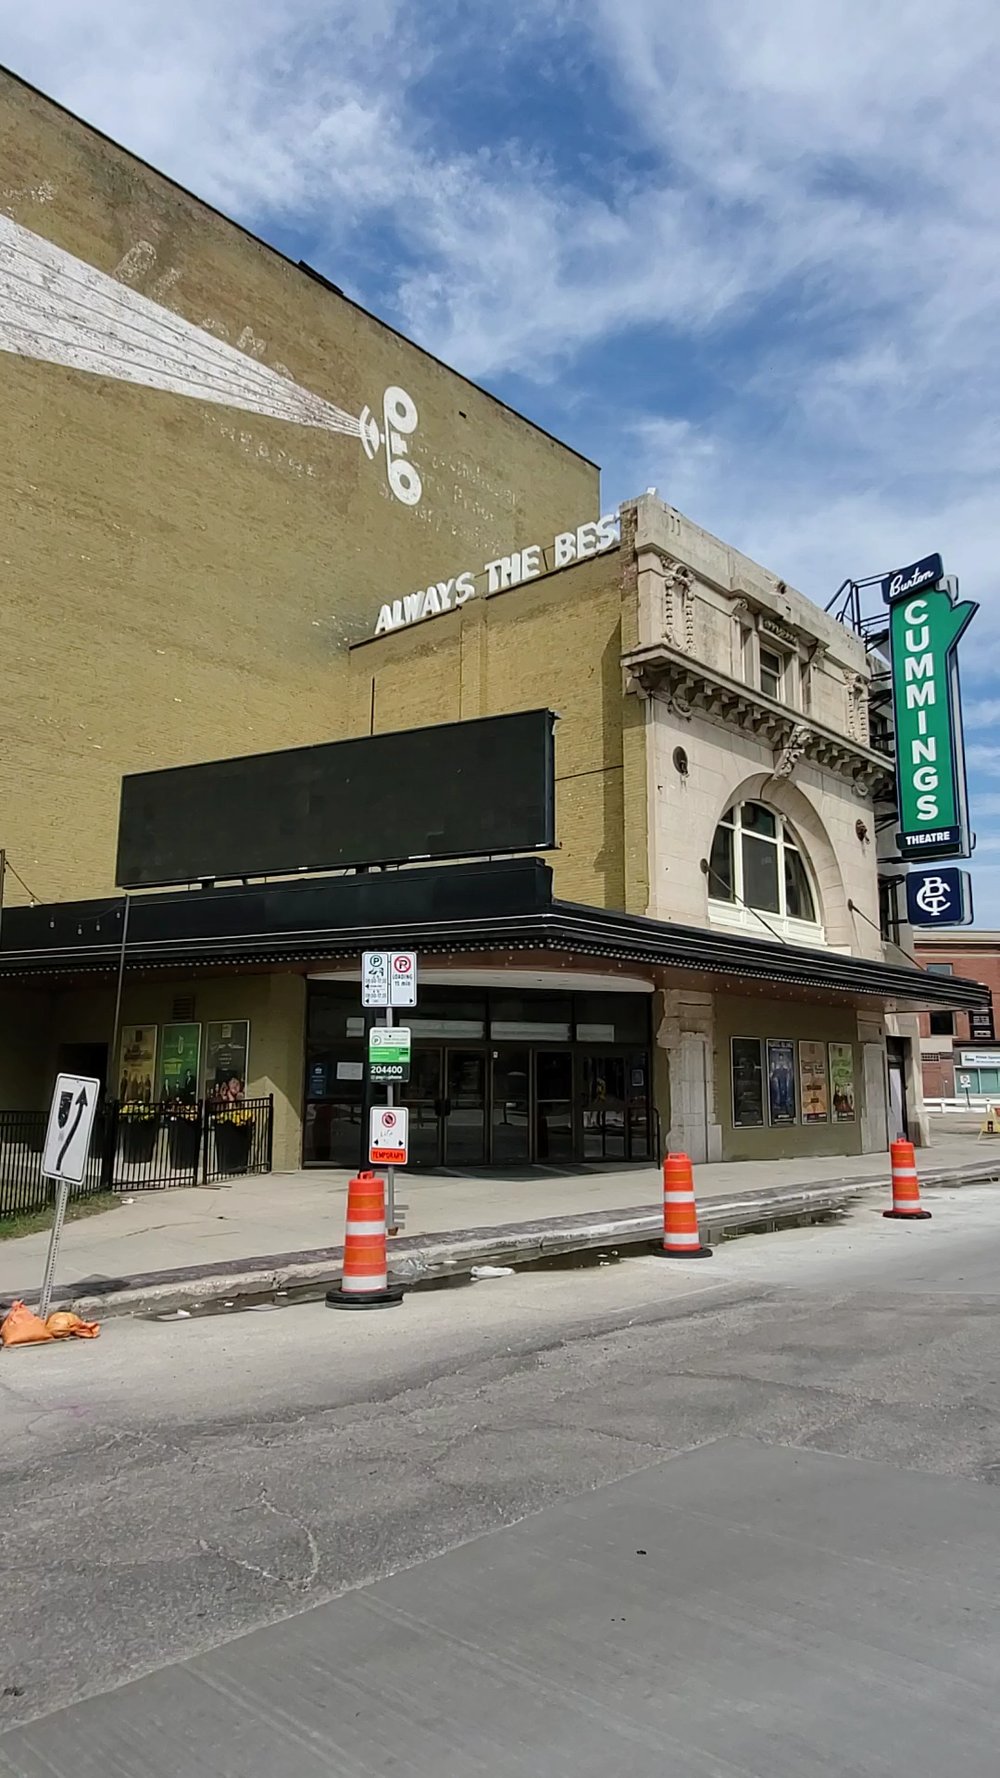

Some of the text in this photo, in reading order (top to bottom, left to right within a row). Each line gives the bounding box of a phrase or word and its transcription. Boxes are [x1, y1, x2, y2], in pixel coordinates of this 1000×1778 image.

[375, 512, 621, 635] ALWAYS THE BES
[889, 568, 935, 598] Burton
[904, 599, 939, 822] CUMMINGS
[905, 831, 951, 846] THEATRE
[370, 1065, 403, 1075] 204400
[372, 1150, 404, 1160] TEMPORARY
